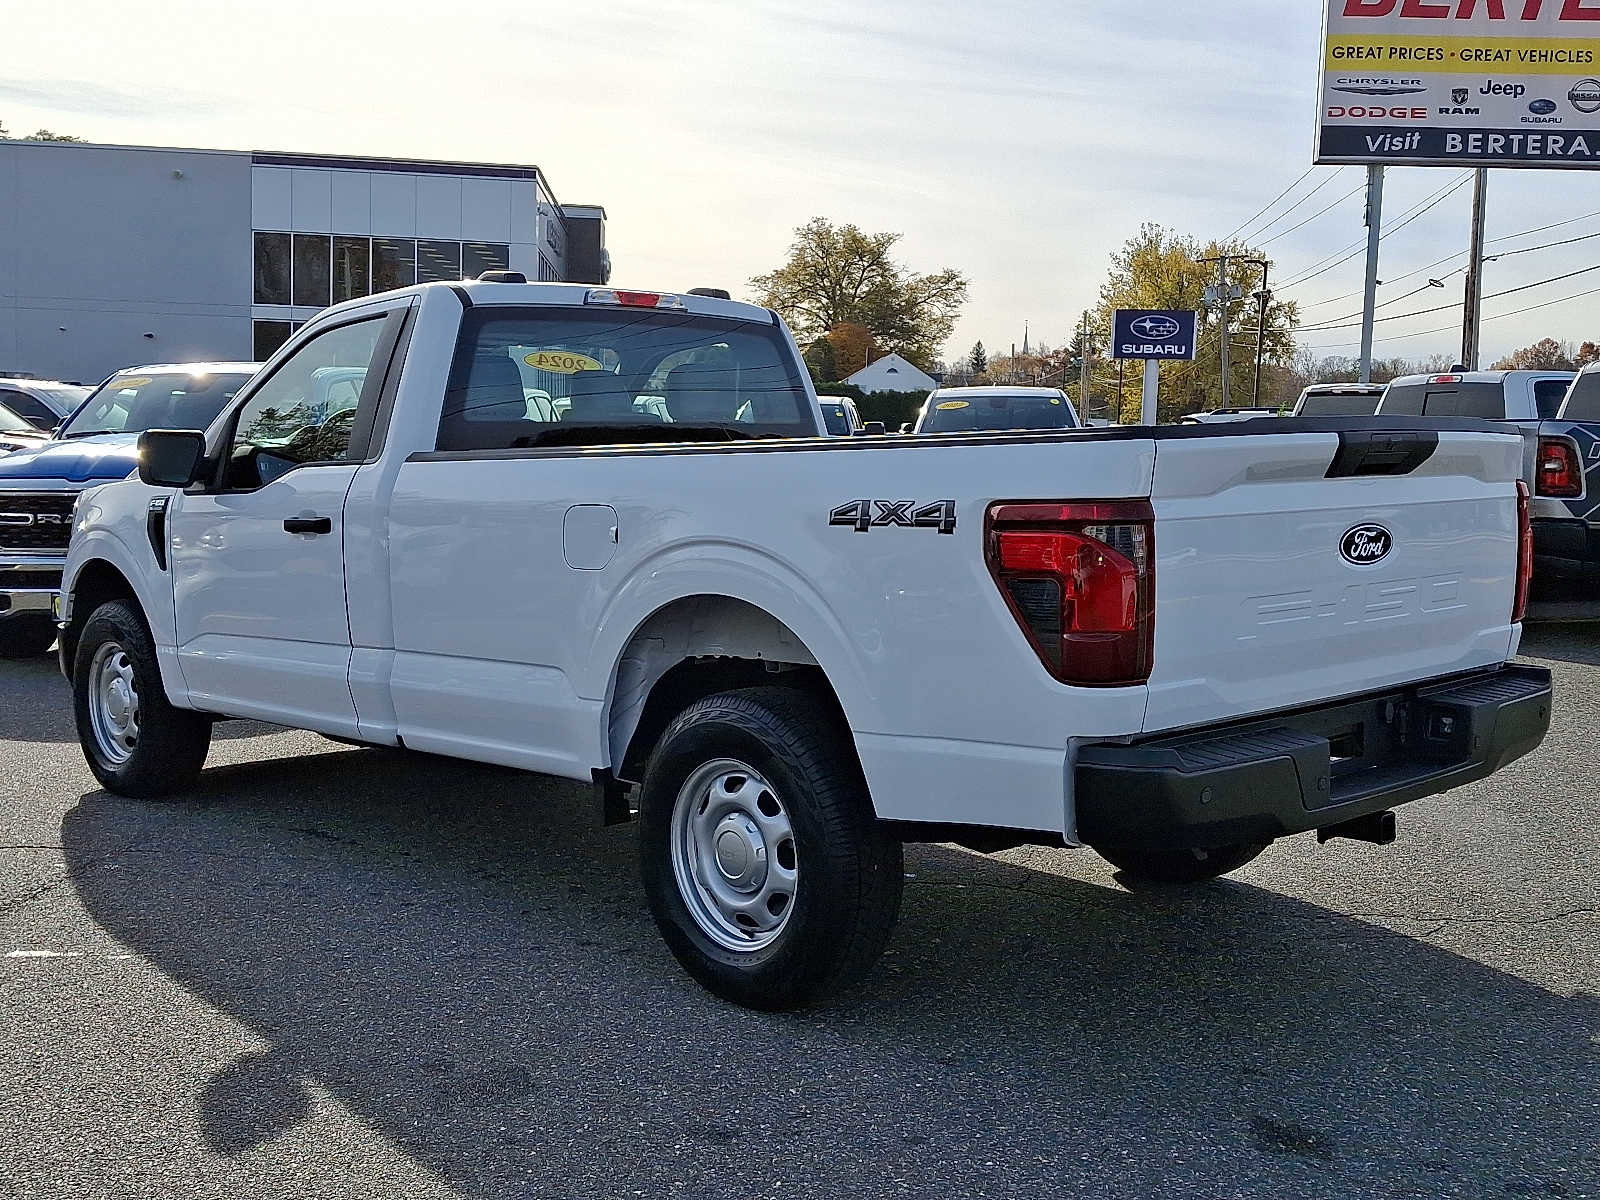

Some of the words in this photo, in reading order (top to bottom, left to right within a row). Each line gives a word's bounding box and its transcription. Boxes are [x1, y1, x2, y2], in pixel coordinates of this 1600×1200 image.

[1331, 46, 1384, 60] GREAT
[1388, 47, 1444, 61] PRICES
[1459, 48, 1512, 62] GREAT
[1517, 49, 1593, 63] VEHICLES
[1336, 78, 1422, 86] CHRYSLER
[1479, 79, 1526, 99] Jeep
[1327, 106, 1428, 119] DODGE
[1438, 107, 1480, 115] RAM
[1520, 116, 1563, 124] SUBARU
[1365, 131, 1421, 152] Visit
[1121, 344, 1186, 355] SUBARU
[1351, 530, 1385, 558] Ford
